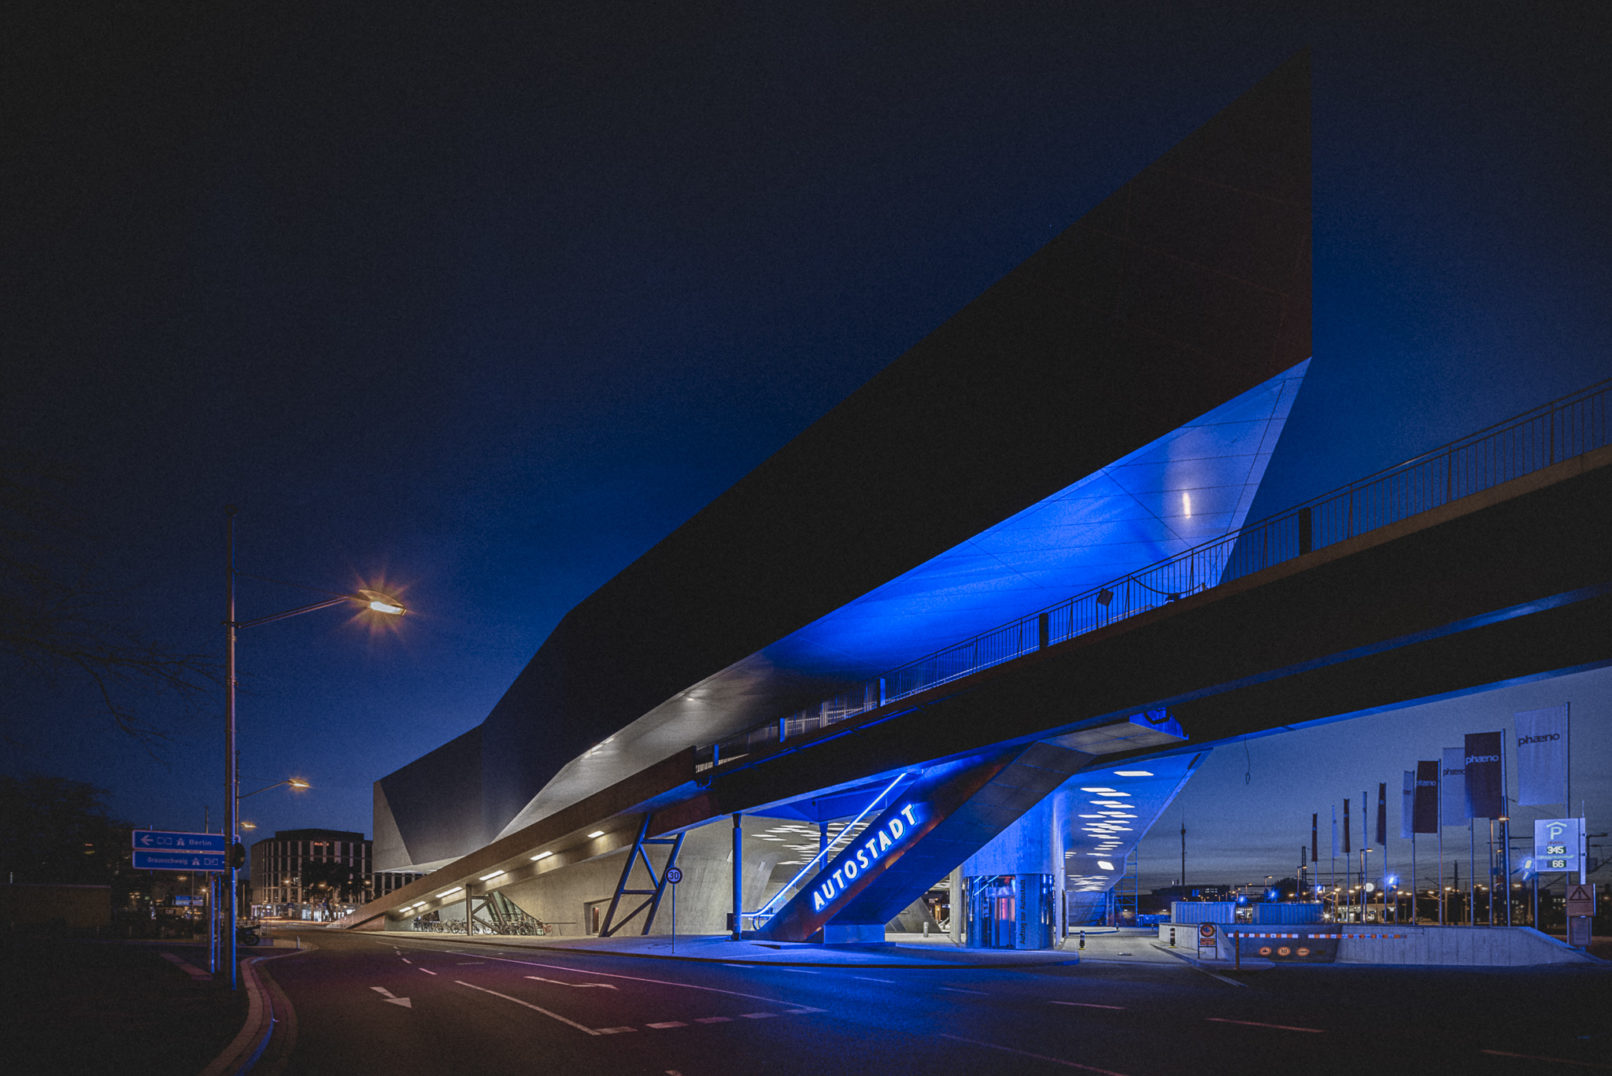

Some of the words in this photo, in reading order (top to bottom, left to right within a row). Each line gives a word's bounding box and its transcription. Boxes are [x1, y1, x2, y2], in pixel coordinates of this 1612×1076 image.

[1550, 826, 1563, 840] P
[188, 838, 212, 847] Berlin
[813, 803, 916, 911] AUTOSTADT
[1552, 859, 1565, 869] 66
[669, 871, 680, 880] 30
